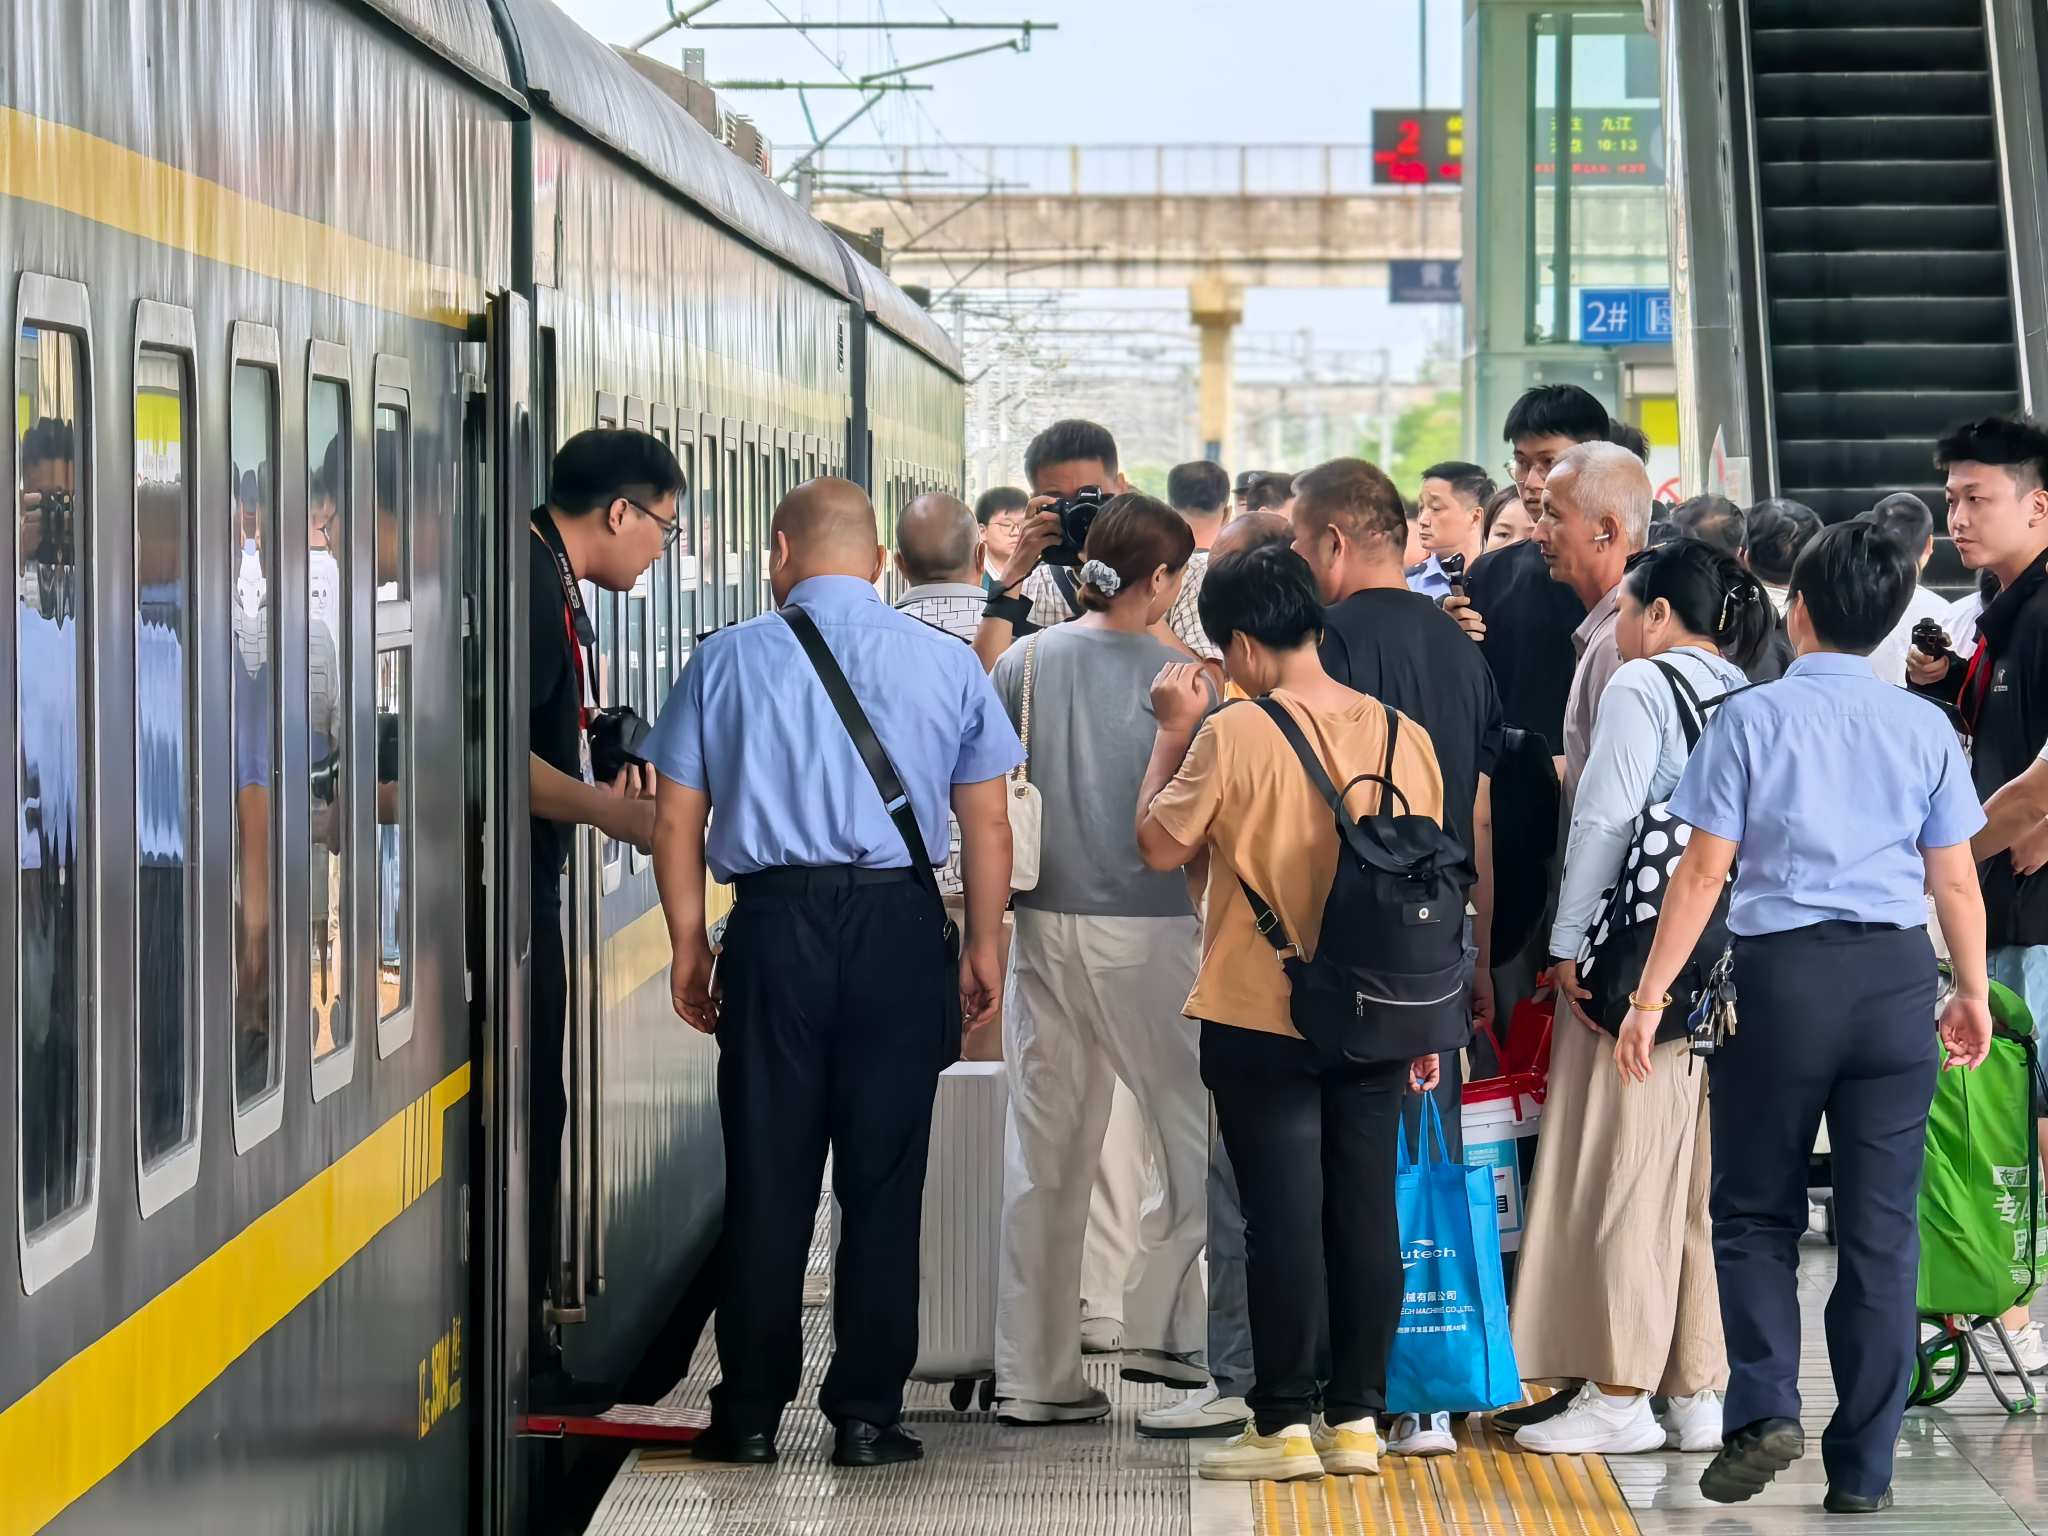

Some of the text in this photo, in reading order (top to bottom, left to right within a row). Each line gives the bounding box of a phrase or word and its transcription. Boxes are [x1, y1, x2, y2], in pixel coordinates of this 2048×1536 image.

[1601, 116, 1632, 131] 九江
[1397, 119, 1420, 155] 2
[1598, 139, 1638, 152] 10:13
[1587, 301, 1628, 332] 2#
[1402, 1291, 1457, 1303] 械有限公司
